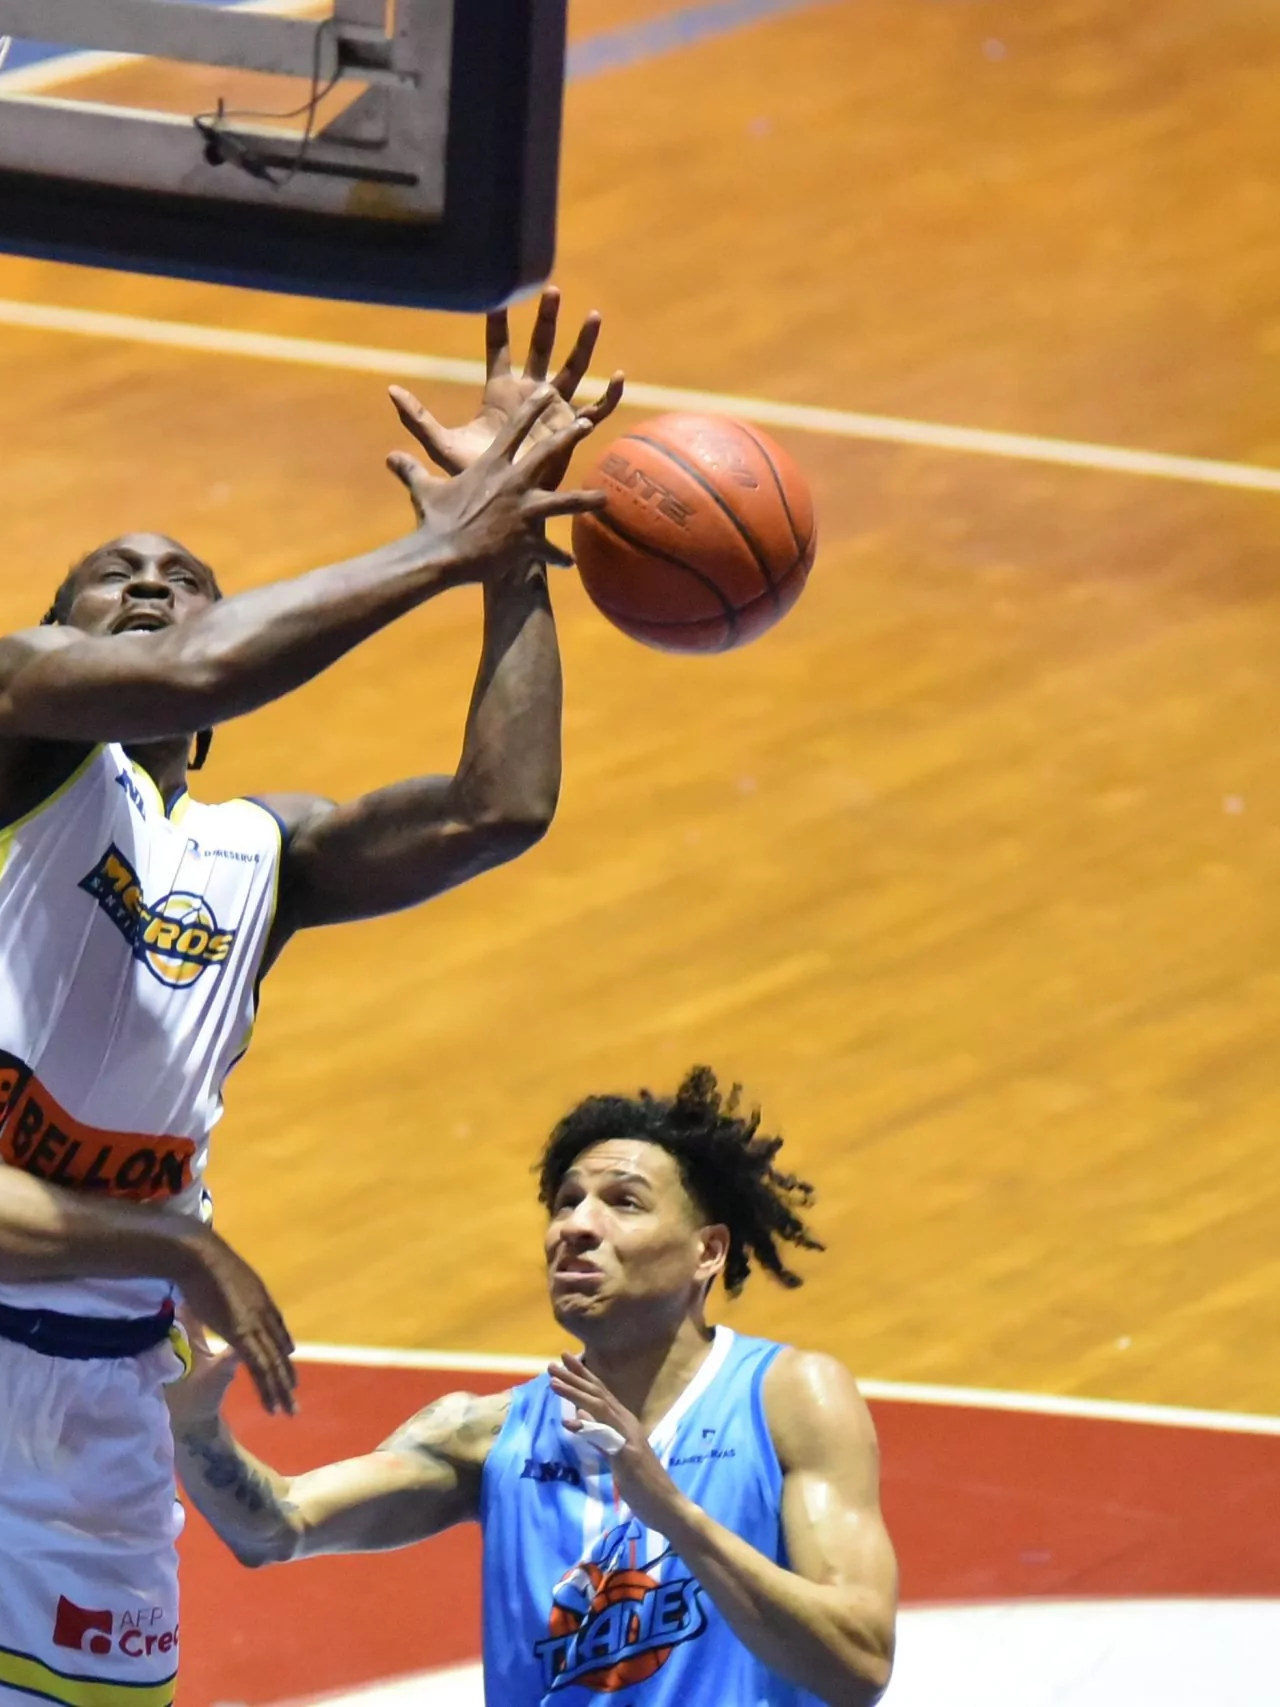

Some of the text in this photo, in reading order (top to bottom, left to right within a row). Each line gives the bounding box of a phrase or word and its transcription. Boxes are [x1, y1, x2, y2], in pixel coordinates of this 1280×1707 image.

[598, 452, 697, 529] ELITE
[99, 851, 235, 963] MEROS
[11, 1096, 195, 1195] BELLON
[121, 1606, 164, 1629] AFP
